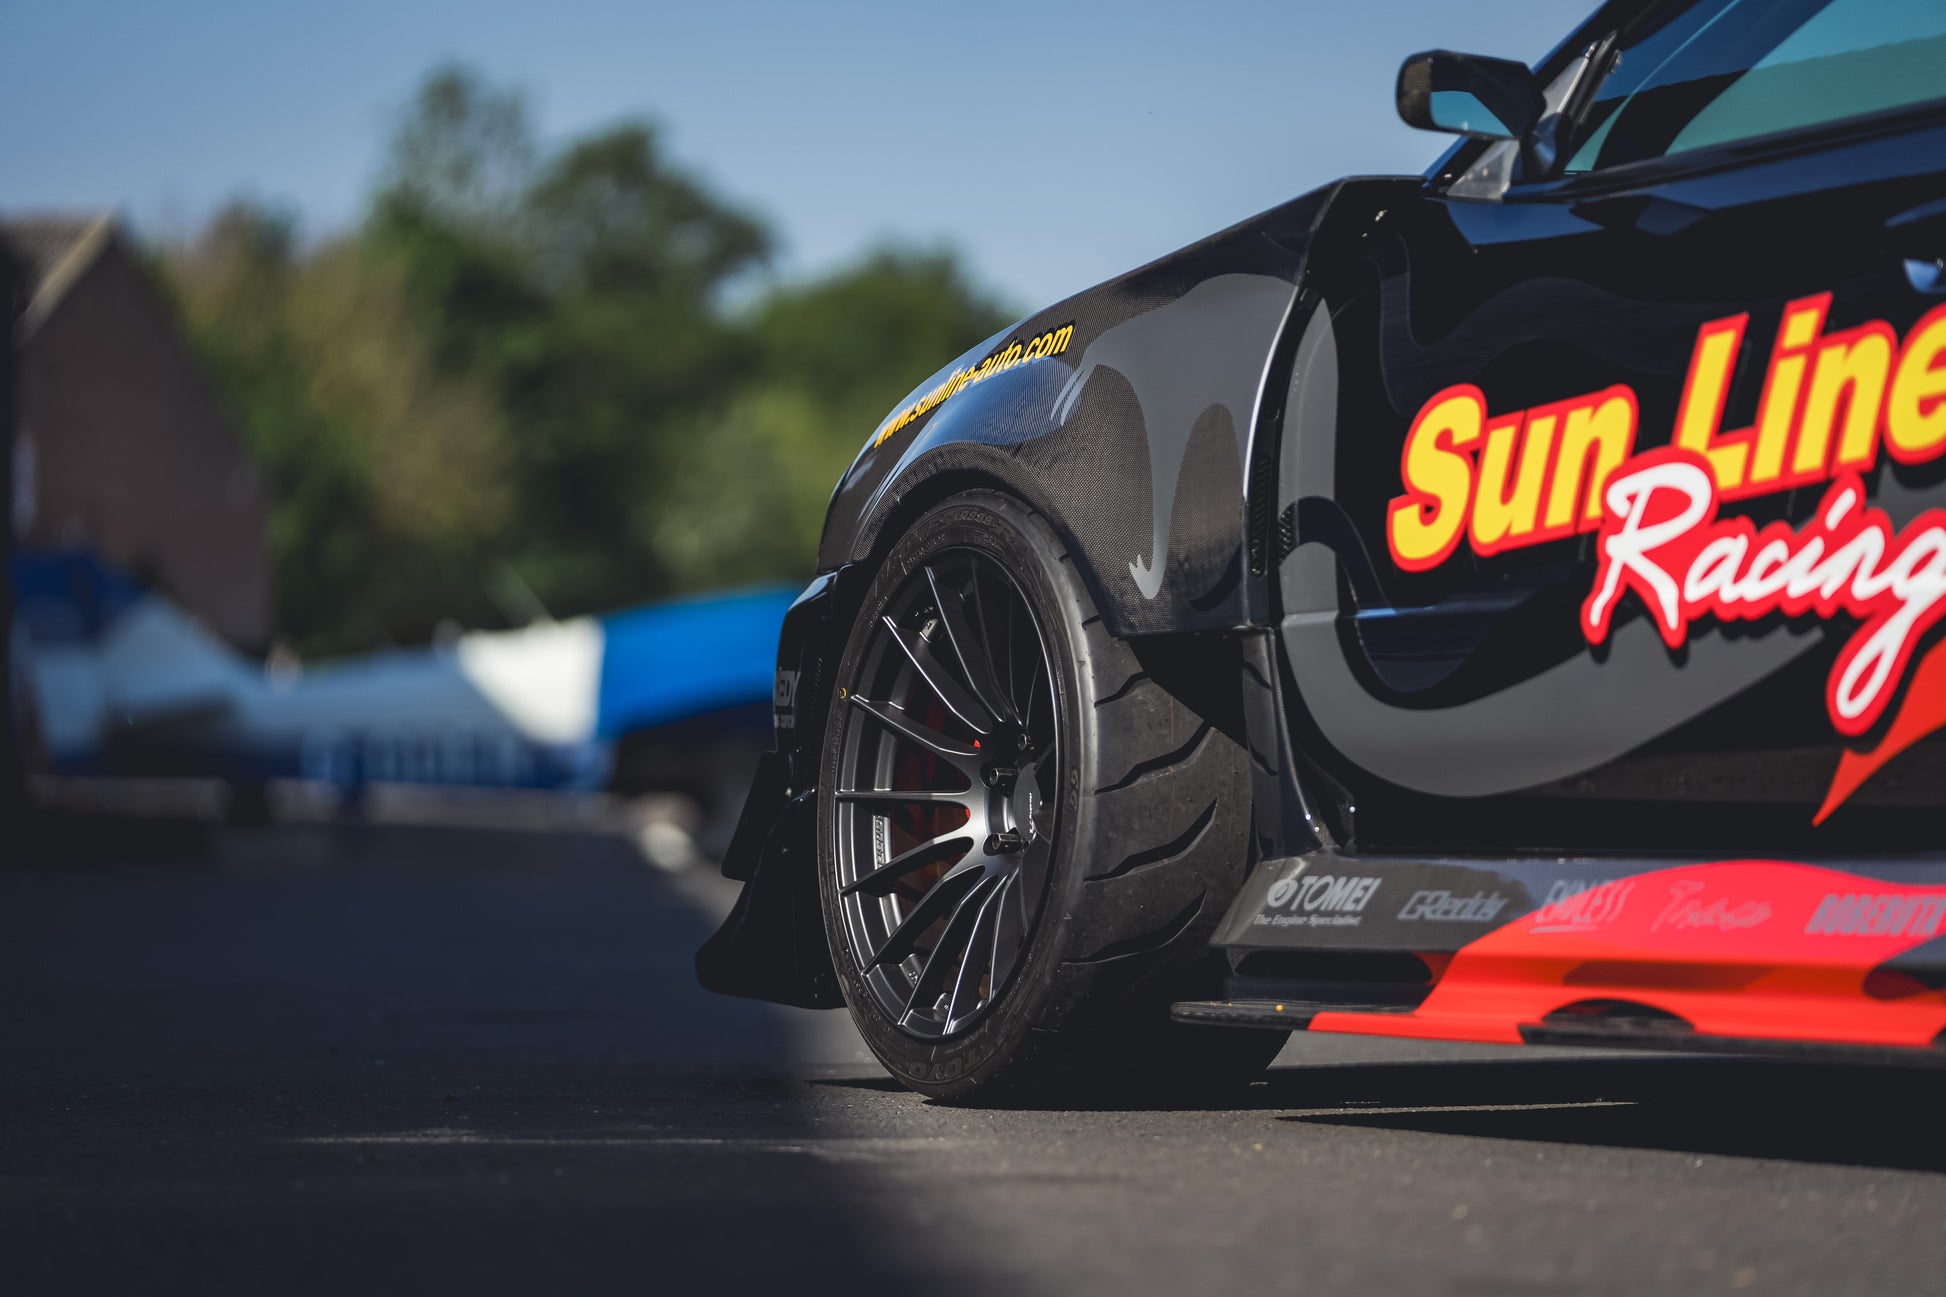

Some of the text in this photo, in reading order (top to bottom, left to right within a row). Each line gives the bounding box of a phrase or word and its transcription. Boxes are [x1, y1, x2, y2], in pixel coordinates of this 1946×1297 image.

[873, 323, 1075, 449] www.sunline-auto.com
[1387, 291, 1946, 572] Sun Line
[1582, 446, 1946, 734] Racing
[1253, 913, 1271, 925] The
[1271, 913, 1308, 927] Engine
[1289, 875, 1383, 912] TOMEI
